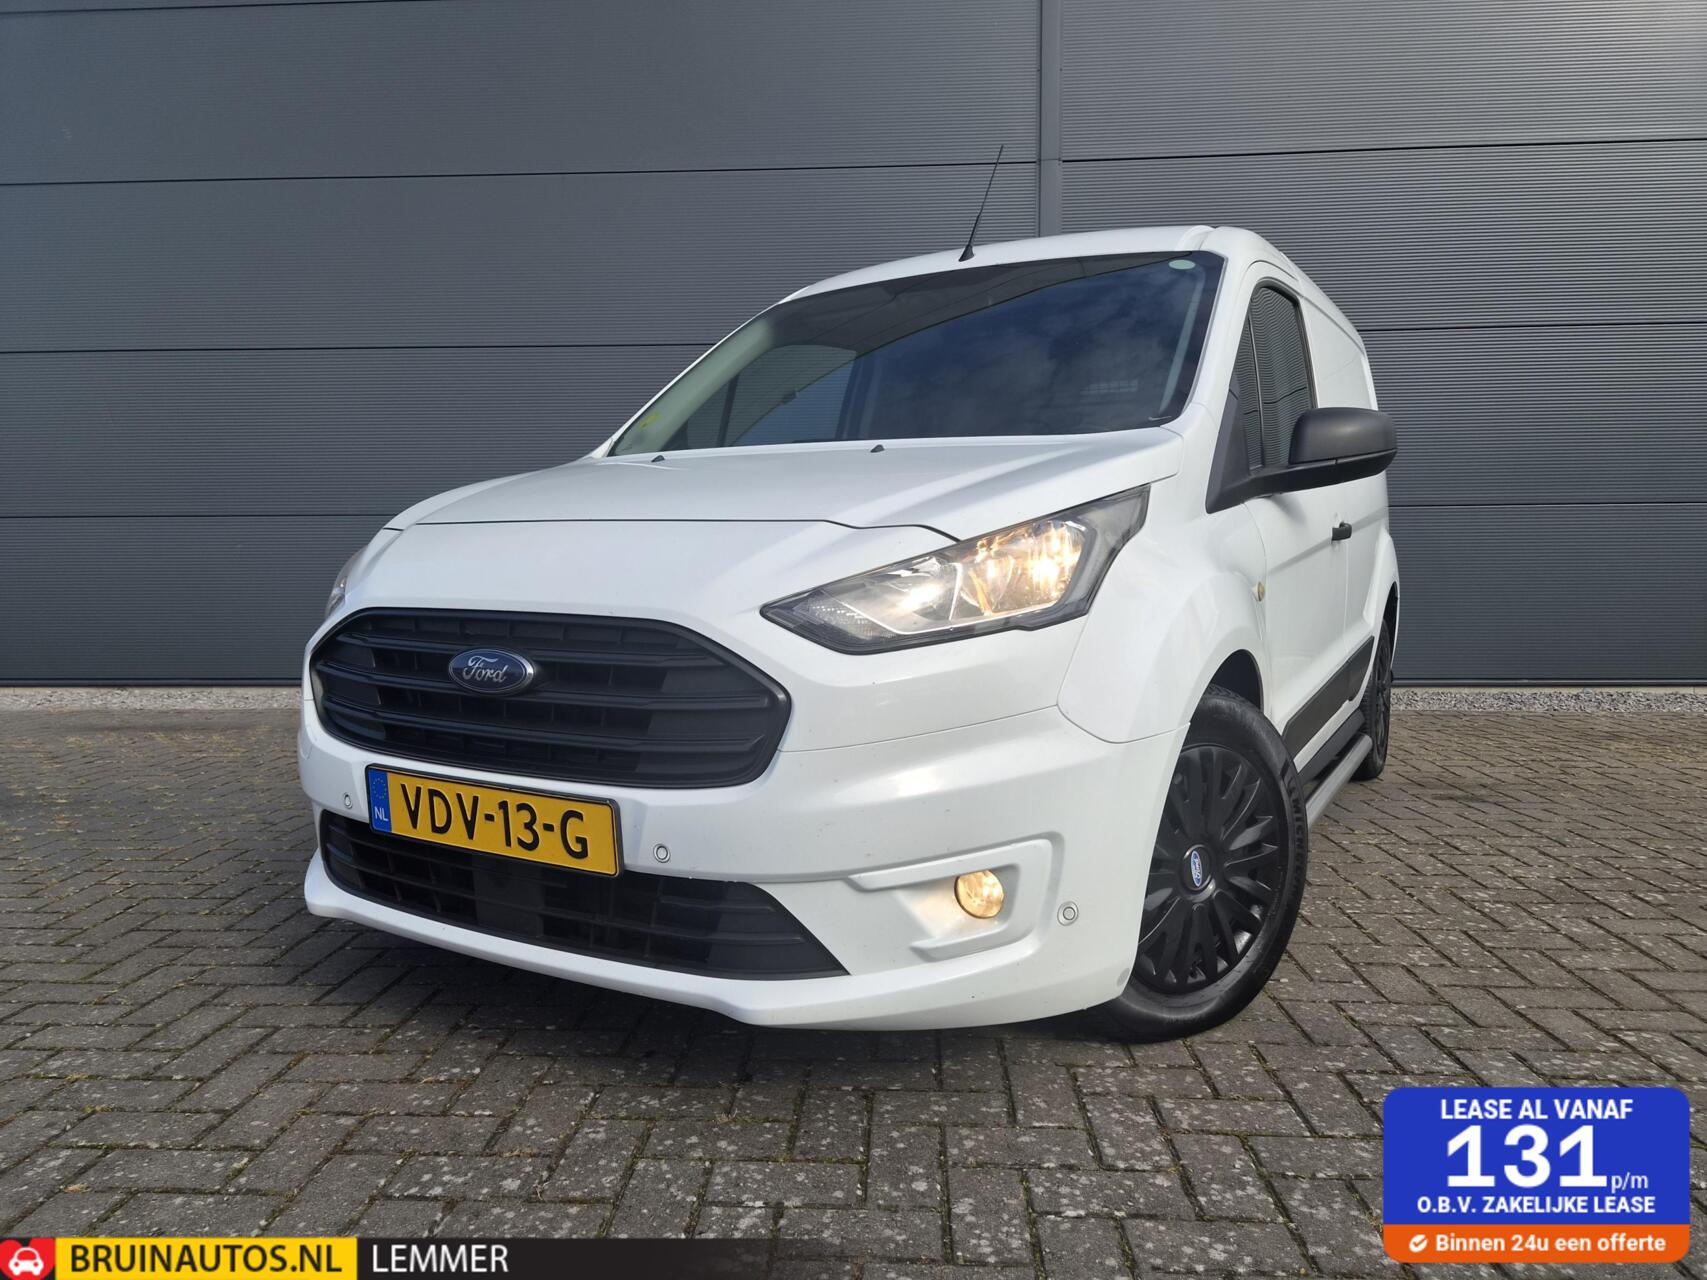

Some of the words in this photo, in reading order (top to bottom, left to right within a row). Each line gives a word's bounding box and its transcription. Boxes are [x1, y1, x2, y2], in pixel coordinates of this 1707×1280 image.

[461, 655, 508, 685] Ford
[374, 806, 389, 823] NL
[400, 783, 589, 860] VDV-13-G
